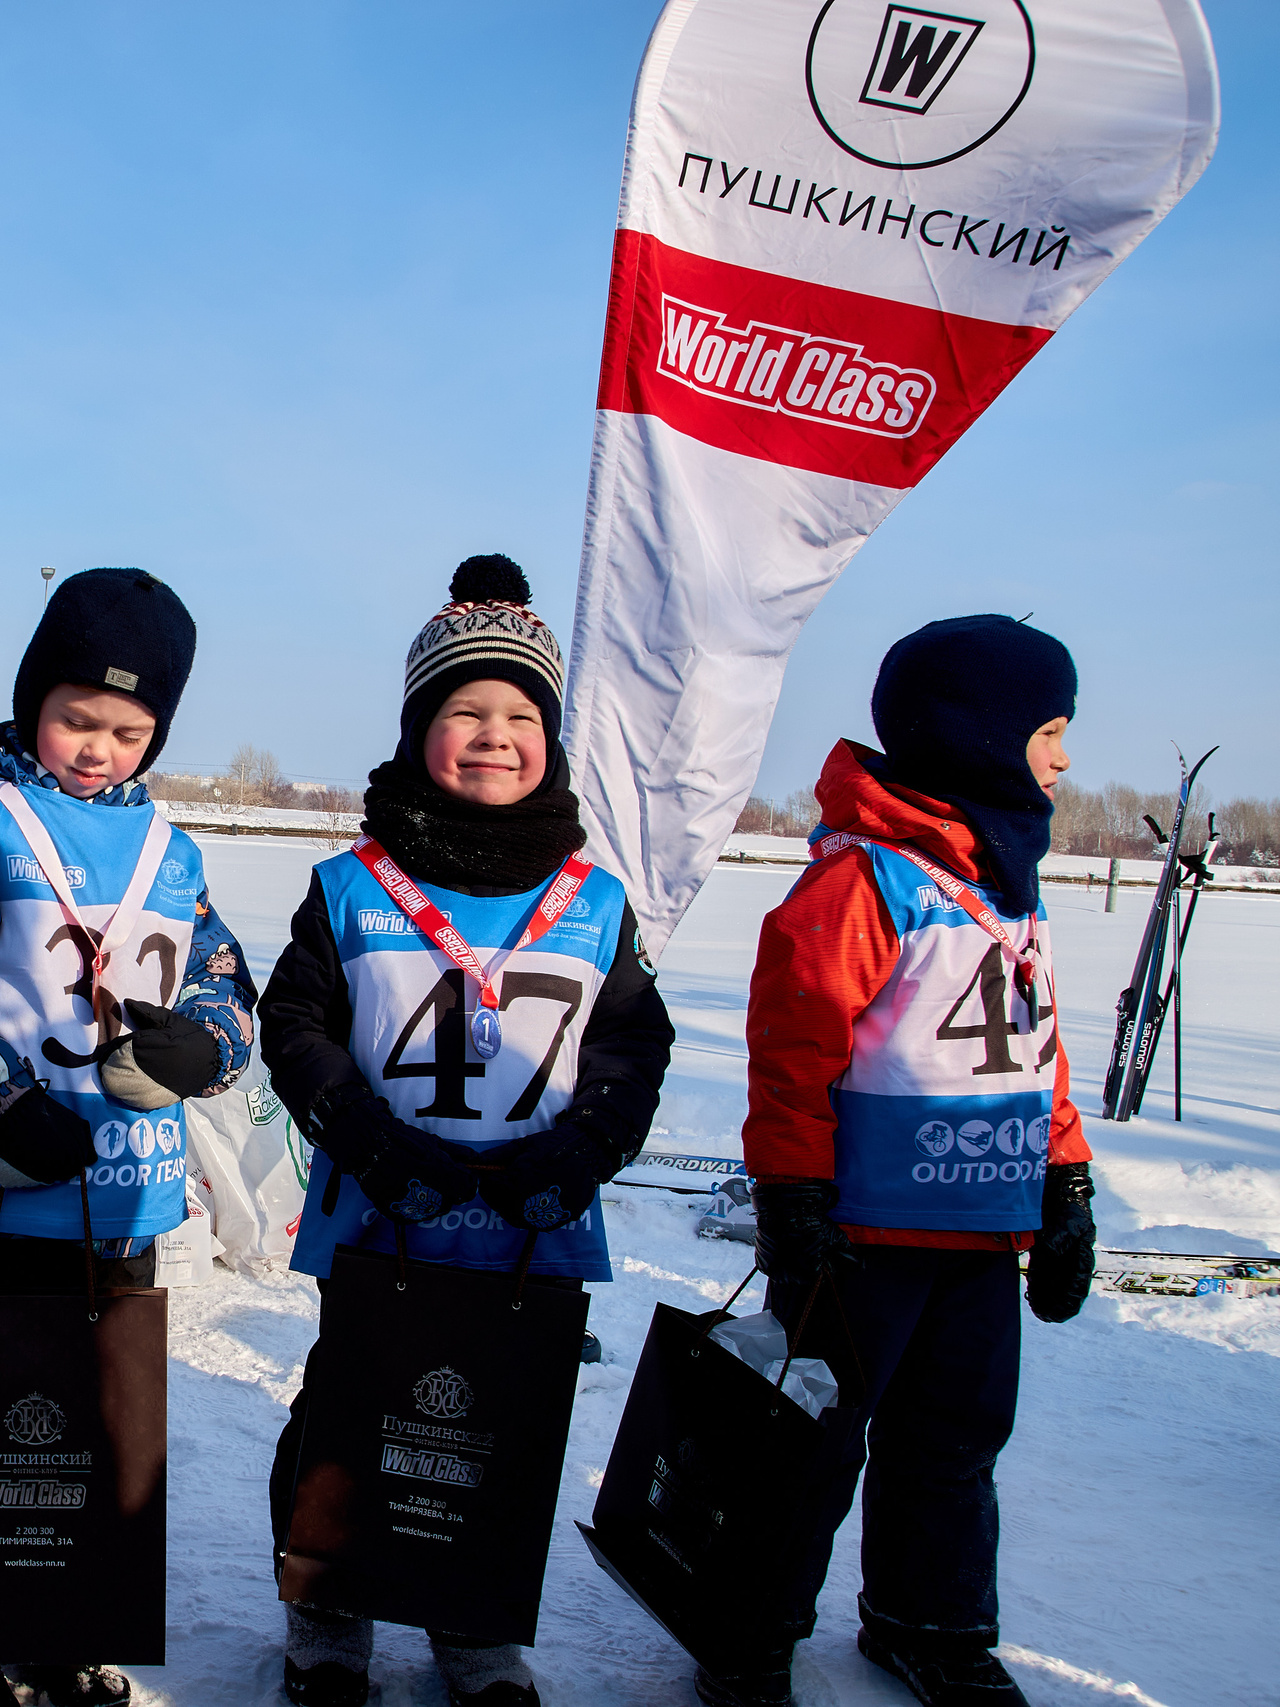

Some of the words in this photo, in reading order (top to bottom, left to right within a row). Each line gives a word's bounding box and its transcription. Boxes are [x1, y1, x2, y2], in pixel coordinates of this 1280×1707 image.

[877, 21, 961, 98] W
[678, 152, 1071, 271] ПУШКИНСКИЙ
[665, 306, 795, 400] World
[785, 347, 924, 428] Class
[376, 857, 403, 888] Class
[553, 873, 579, 902] World
[927, 866, 963, 898] World
[391, 878, 427, 914] World
[360, 911, 406, 933] World
[437, 927, 466, 957] Class
[482, 1017, 490, 1042] 1
[1118, 1019, 1135, 1068] salomon
[382, 968, 583, 1123] 47
[1134, 1021, 1152, 1070] salomon
[643, 1155, 744, 1174] NORDWAY
[384, 1447, 434, 1477] World
[434, 1456, 480, 1485] Class
[37, 1482, 84, 1506] Class
[415, 1496, 431, 1507] 200
[431, 1499, 447, 1510] 300
[388, 1501, 446, 1521] ТИМИРЯЗЕВА,
[15, 1526, 21, 1536] 2
[22, 1526, 38, 1536] 200
[39, 1526, 55, 1536] 300
[392, 1524, 453, 1543] worldclass-nn.ru
[4, 1558, 66, 1568] worldclass-nn.ru
